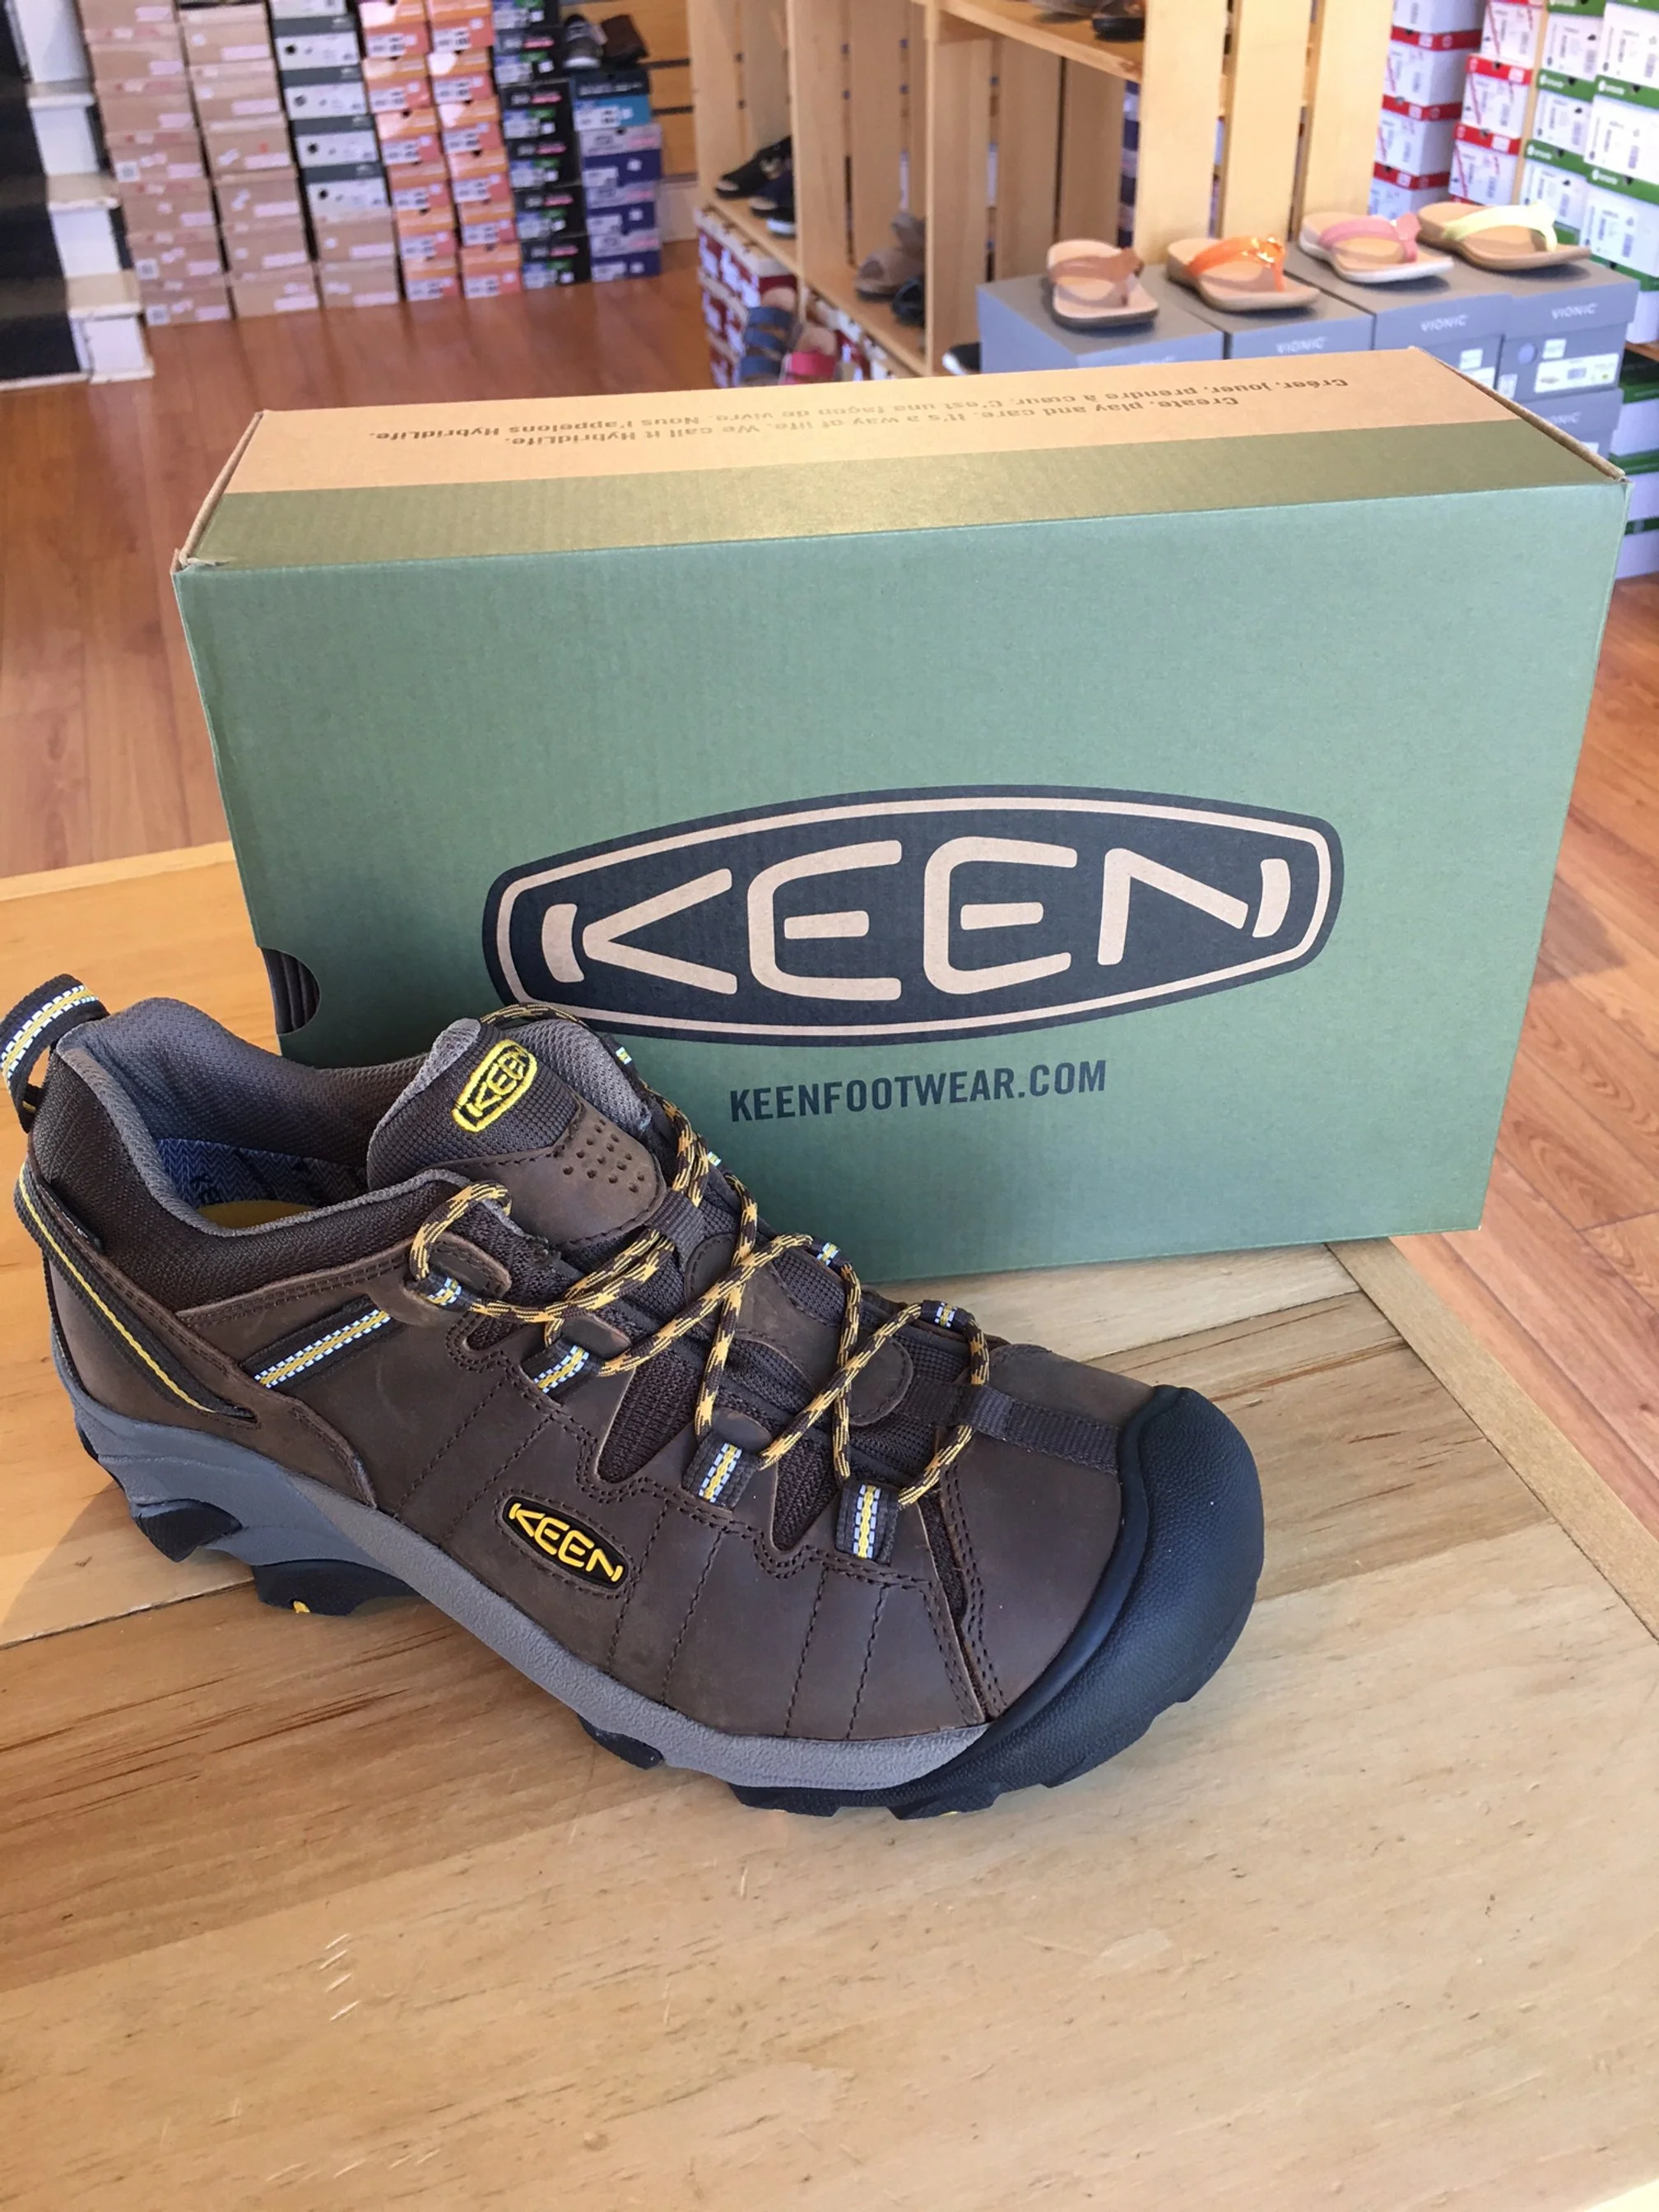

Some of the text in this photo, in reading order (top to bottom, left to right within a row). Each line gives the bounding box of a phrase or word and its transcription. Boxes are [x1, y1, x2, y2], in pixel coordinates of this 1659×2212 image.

[1550, 302, 1598, 320] VIONIC
[1420, 314, 1470, 332] VIONIC
[1203, 382, 1272, 393] jouer,
[1275, 379, 1349, 388] Créer,
[1083, 394, 1099, 402] à
[1104, 387, 1198, 400] prendre
[893, 403, 936, 411] une
[945, 400, 1004, 410] C'est
[1095, 402, 1144, 412] play
[782, 410, 810, 418] de
[973, 409, 1035, 418] care.
[1042, 406, 1087, 416] and
[641, 416, 699, 426] Nous
[709, 412, 774, 421] vivre.
[853, 417, 899, 425] way
[927, 413, 966, 422] It's
[509, 421, 633, 434] l'appelons
[766, 421, 813, 430] life.
[822, 419, 843, 428] of
[369, 426, 500, 440] HybridLife.
[645, 430, 660, 439] it
[670, 426, 713, 438] call
[723, 425, 760, 434] We
[504, 431, 636, 445] HybridLife.
[541, 835, 1291, 1001] KEEN
[465, 1046, 527, 1118] KEEN
[730, 1059, 1107, 1122] KEENFOOTWEAR.COM
[509, 1503, 624, 1582] KEEN
